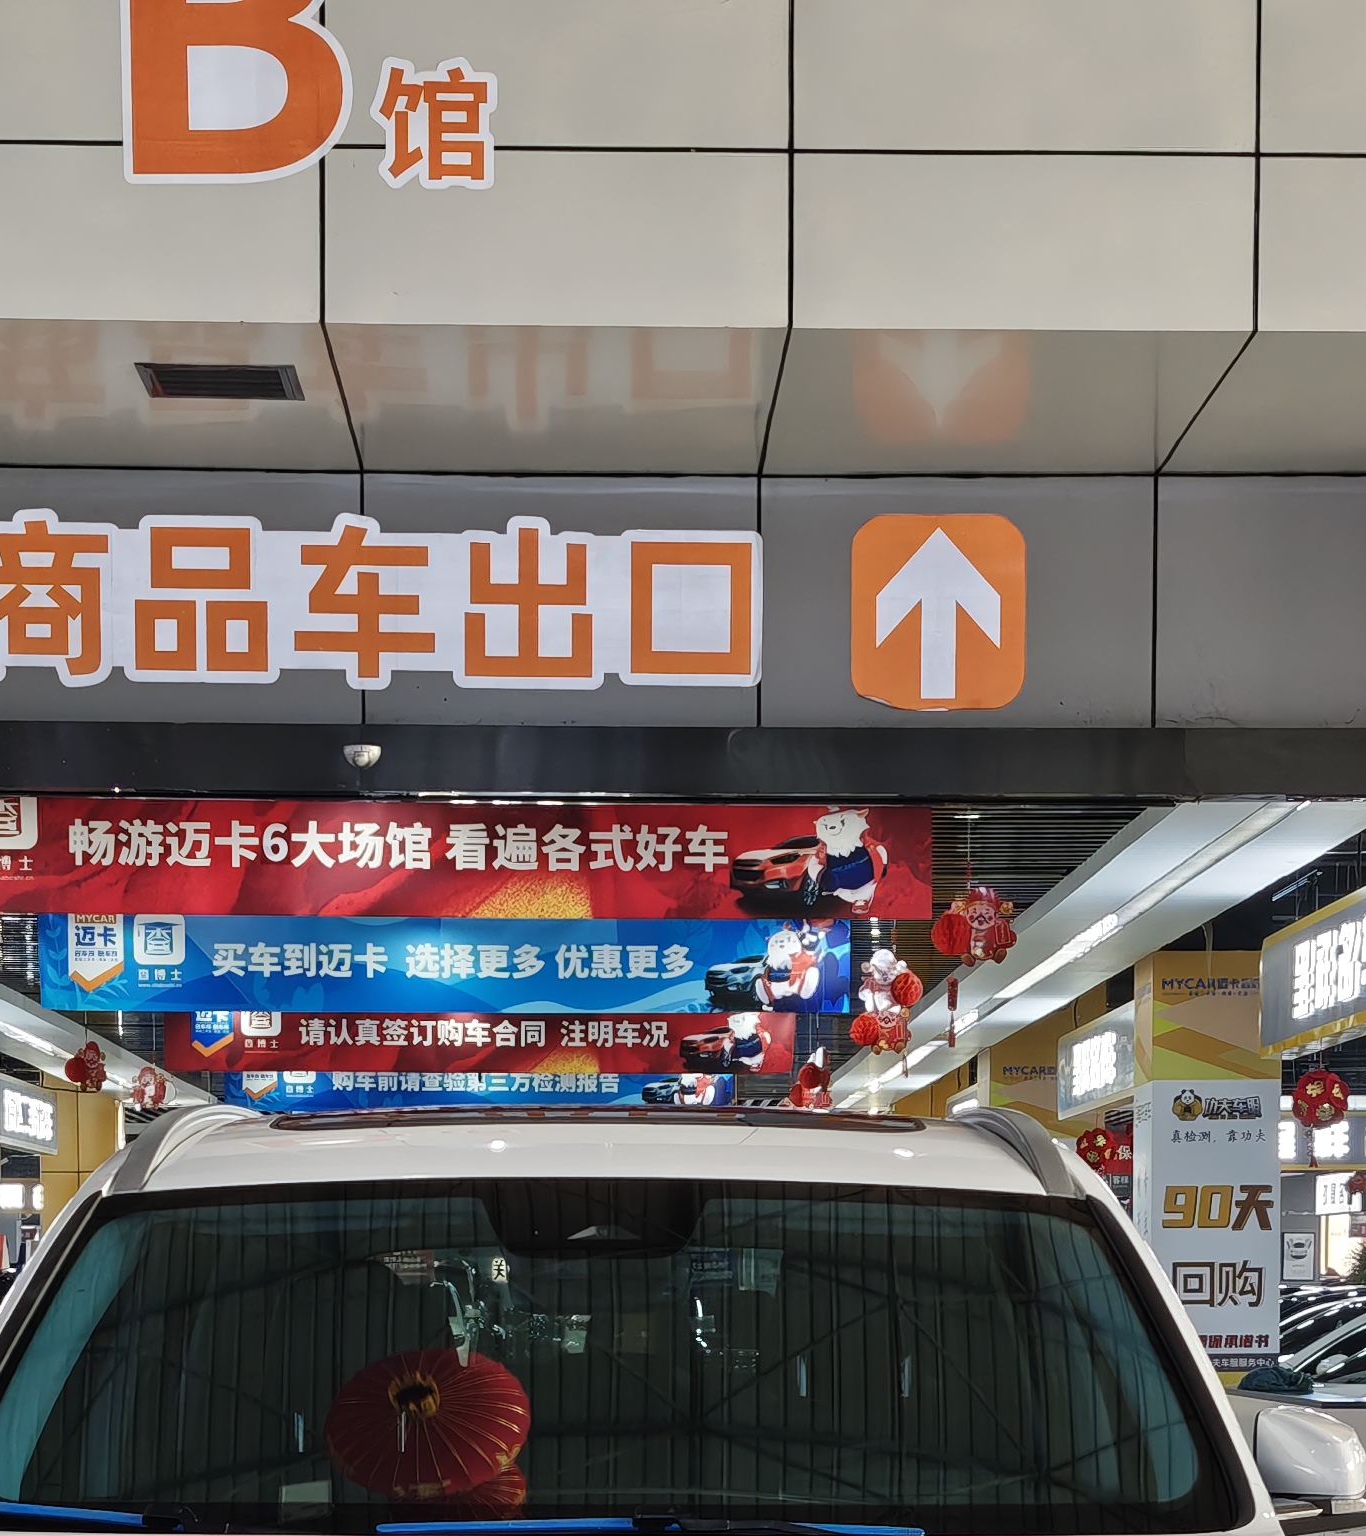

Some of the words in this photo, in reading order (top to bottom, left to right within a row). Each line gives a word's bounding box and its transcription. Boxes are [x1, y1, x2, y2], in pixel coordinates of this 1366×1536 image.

[68, 819, 432, 872] 畅游迈卡6大场馆
[445, 824, 730, 872] 看遍各式好车
[74, 925, 117, 947] 迈卡
[212, 942, 389, 980] 买车到迈卡
[405, 943, 544, 980] 选择更多
[555, 943, 694, 980] 优惠更多
[298, 1018, 546, 1048] 请认真签订购车合同
[560, 1018, 670, 1048] 注明车况
[332, 1072, 620, 1094] 购车前请查验第三方检测报告
[1161, 1185, 1274, 1231] 90天
[1172, 1260, 1265, 1308] 回购
